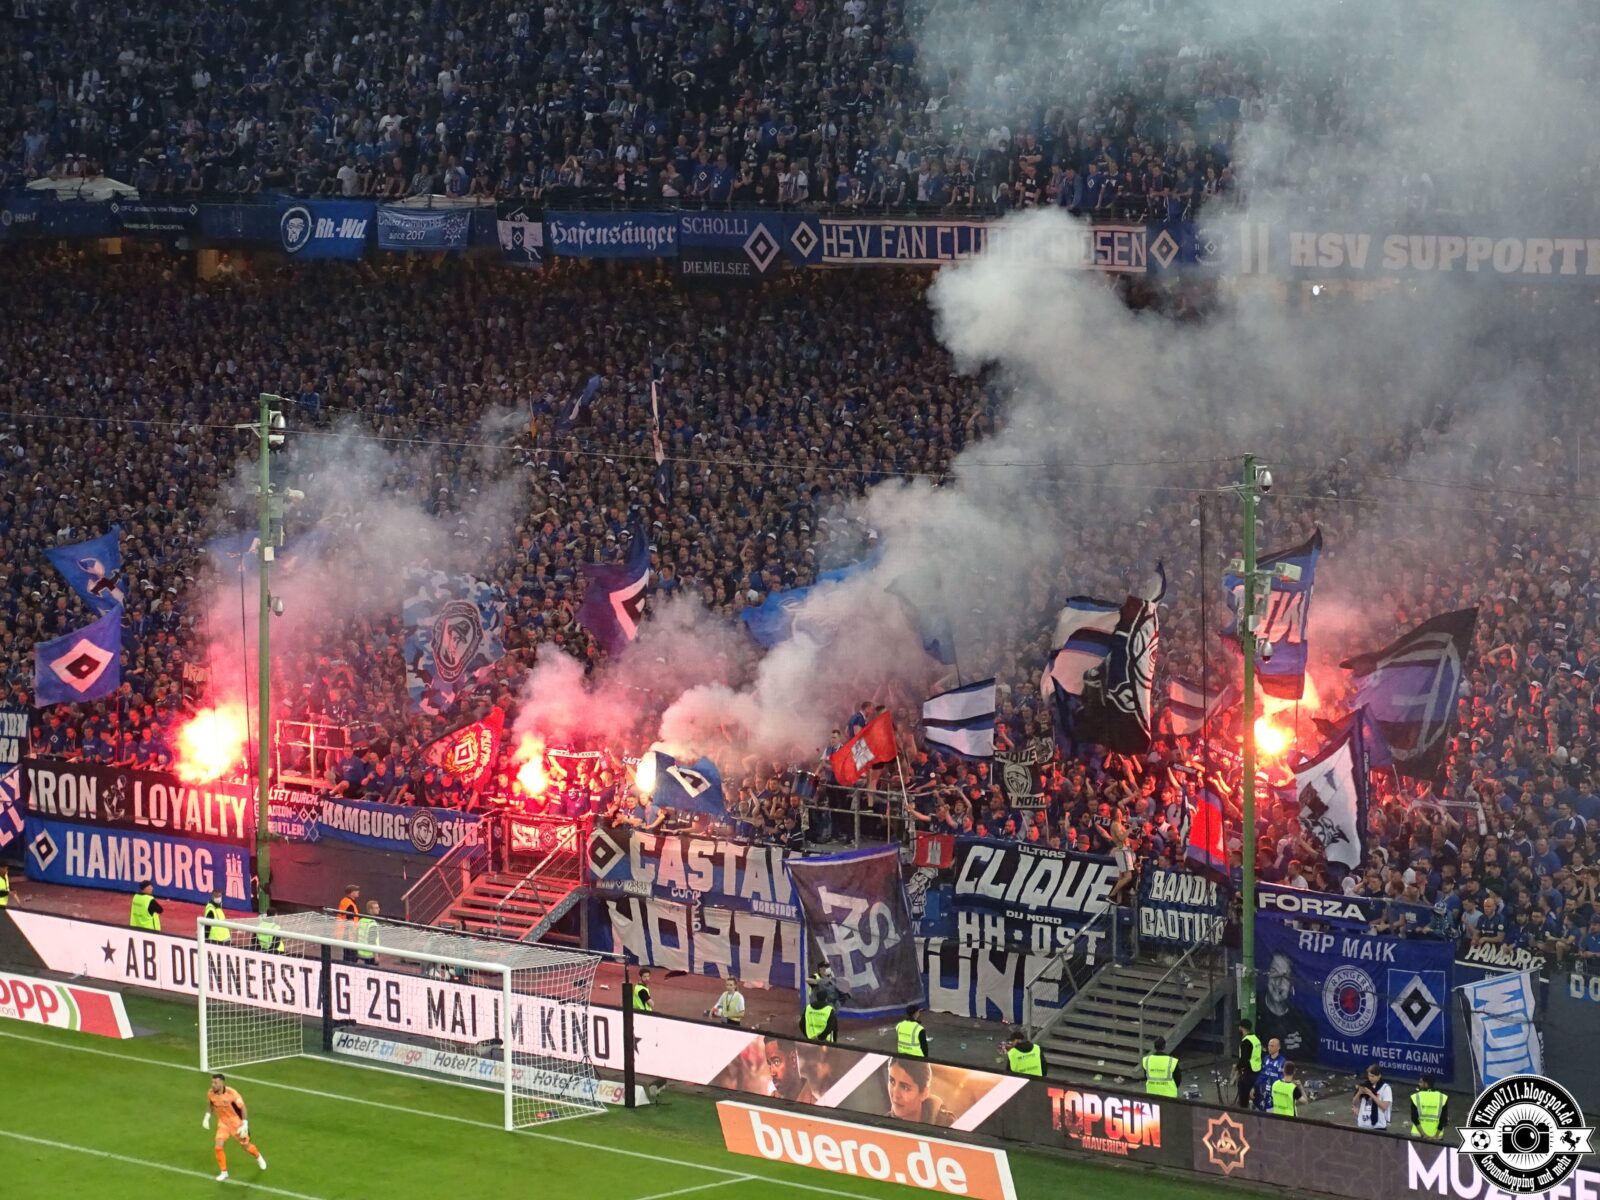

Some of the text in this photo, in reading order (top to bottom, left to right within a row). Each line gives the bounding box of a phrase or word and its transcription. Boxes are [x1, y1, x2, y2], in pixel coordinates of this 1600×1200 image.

[314, 217, 368, 240] Rh.-Wd.
[406, 230, 426, 241] 2017
[681, 217, 749, 236] SCHOLLI
[822, 225, 870, 258] HSV
[881, 225, 926, 259] FAN
[1289, 231, 1371, 269] HSV
[682, 261, 750, 276] DIEMELSEE
[27, 768, 97, 819] IRON
[134, 781, 247, 839] LOYALTY
[66, 830, 214, 894] HAMBURG
[1017, 844, 1066, 859] ULTRAS
[955, 845, 1119, 914] CLIQUE
[1006, 910, 1063, 925] DU NORD
[1258, 891, 1367, 922] FORZA
[1298, 930, 1397, 963] RIP MAIK
[1464, 942, 1546, 970] HAMBURG
[1331, 970, 1372, 991] RANGERS
[126, 936, 157, 982] AB
[366, 977, 412, 1026] 26.
[426, 986, 478, 1038] MAI
[540, 1005, 610, 1060] KINO
[1351, 1043, 1369, 1057] WE
[1371, 1046, 1402, 1061] MEET
[336, 1031, 624, 1102] Hotel? trivago Hotel? trivgo Hotel? trivag
[1423, 1065, 1445, 1076] LOYAL
[747, 1109, 968, 1195] buero.de
[1082, 1136, 1129, 1155] MAVERICK
